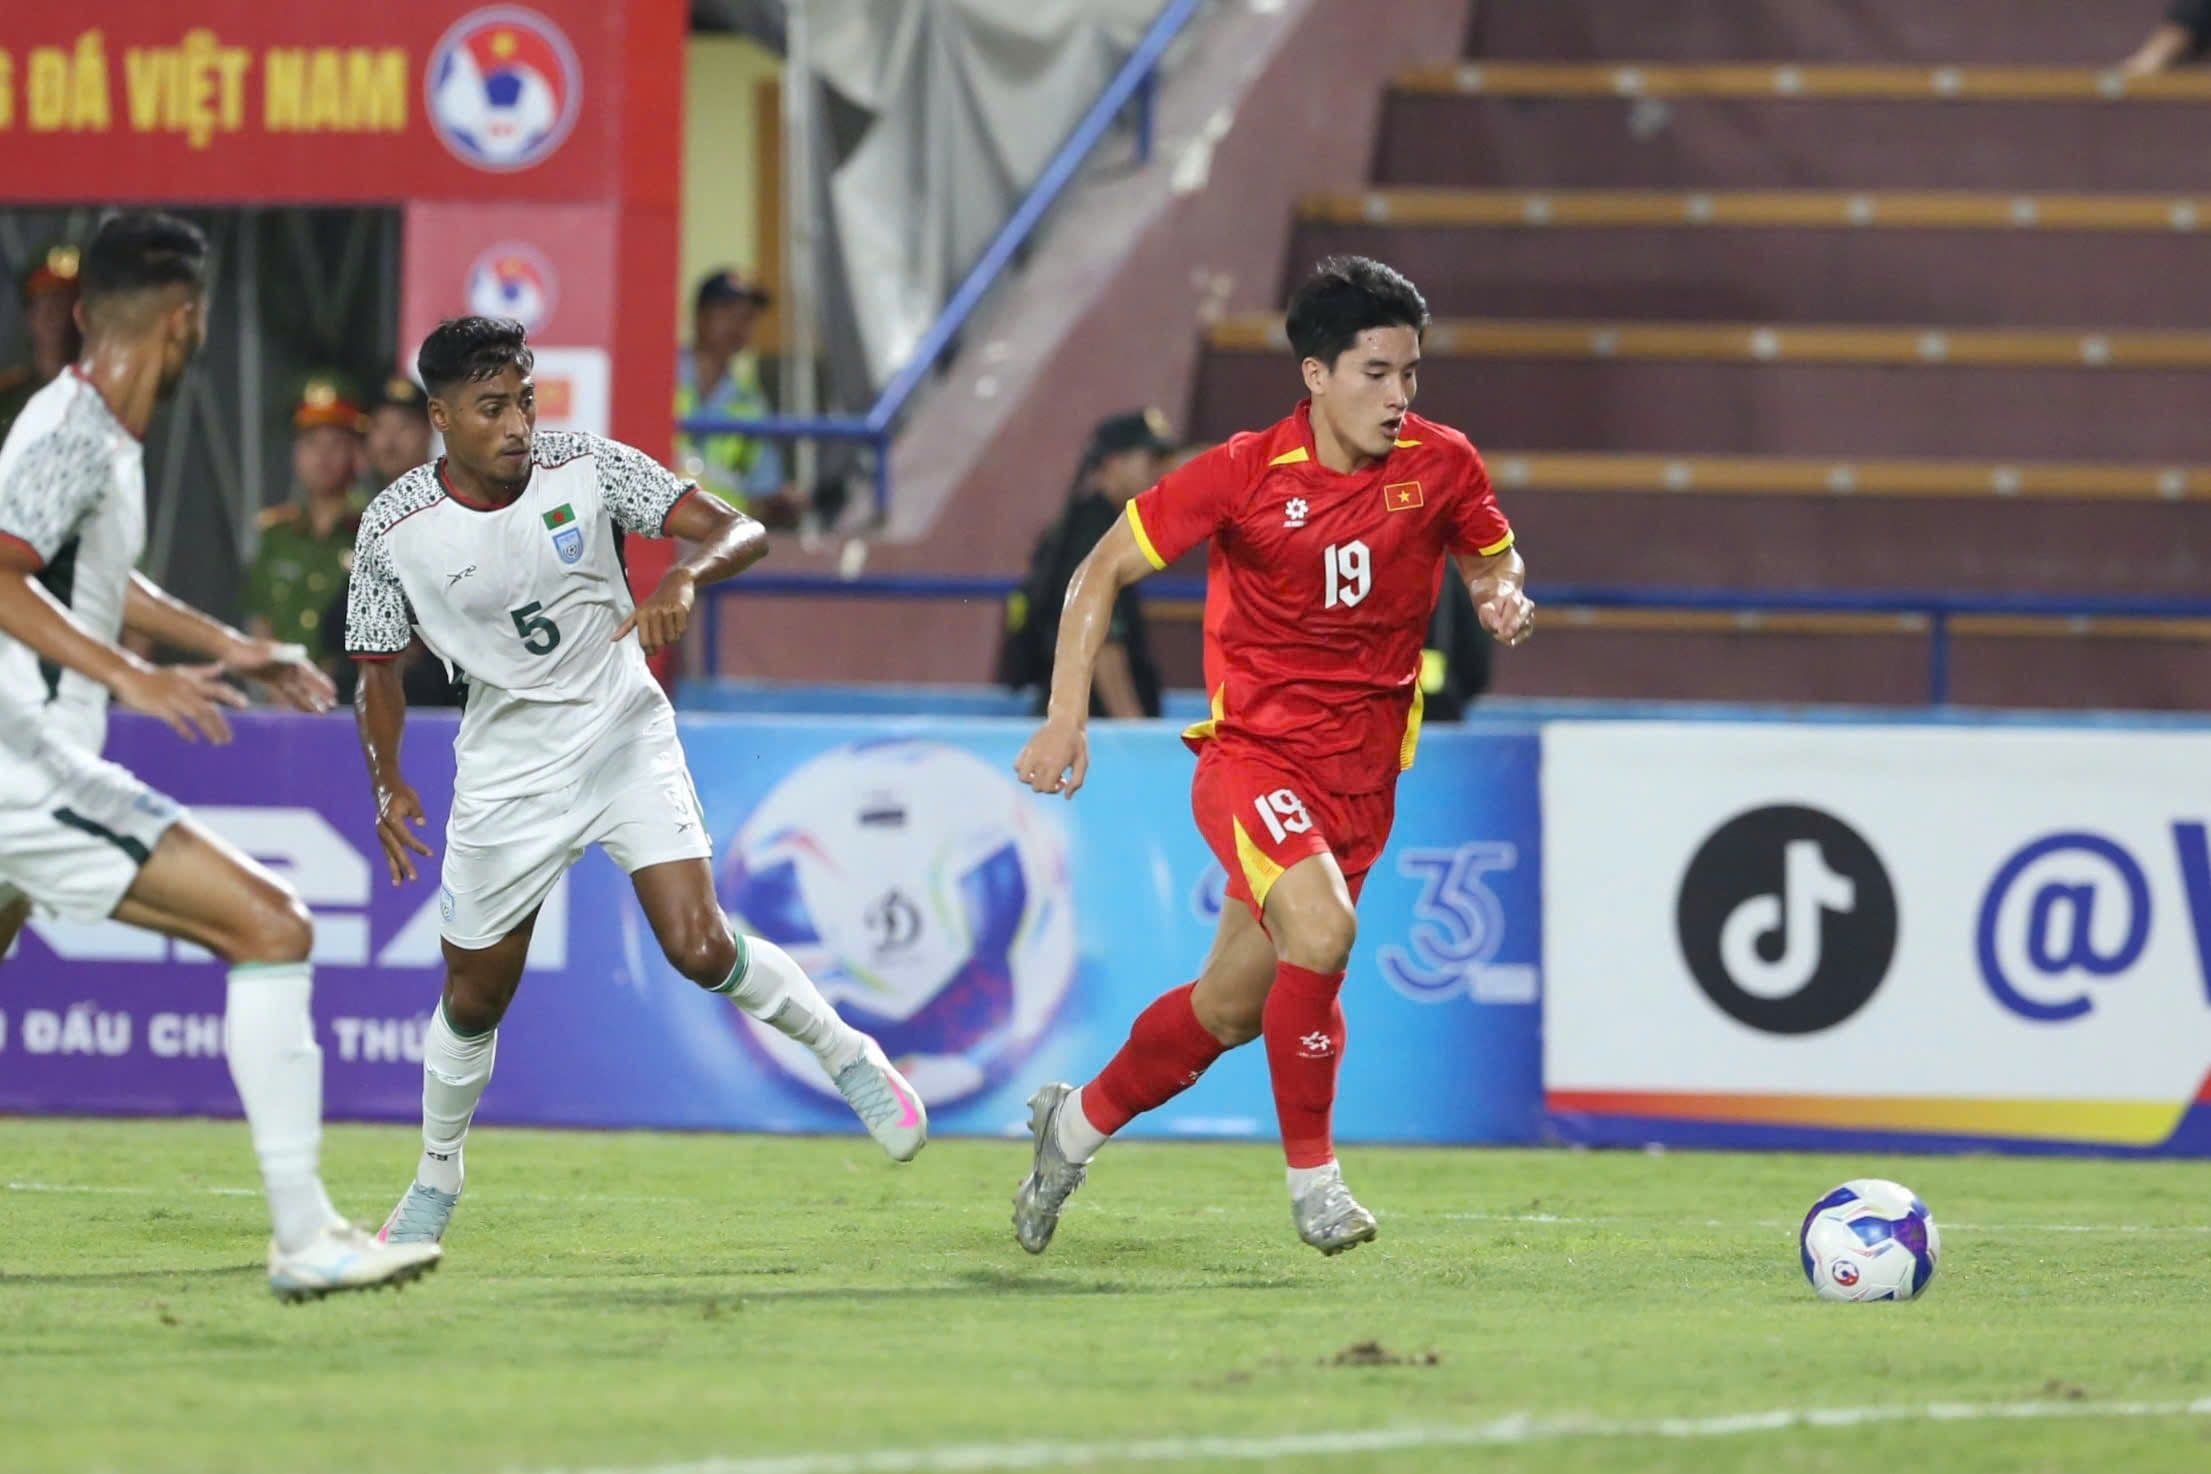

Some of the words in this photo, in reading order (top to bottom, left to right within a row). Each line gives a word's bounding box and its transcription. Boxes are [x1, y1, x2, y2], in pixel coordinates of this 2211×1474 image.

[28, 26, 110, 132] ĐÁ
[125, 26, 251, 149] VIỆT
[263, 44, 409, 132] NAM
[1324, 540, 1371, 609] 19
[510, 600, 560, 655] 5
[1254, 788, 1313, 845] 19
